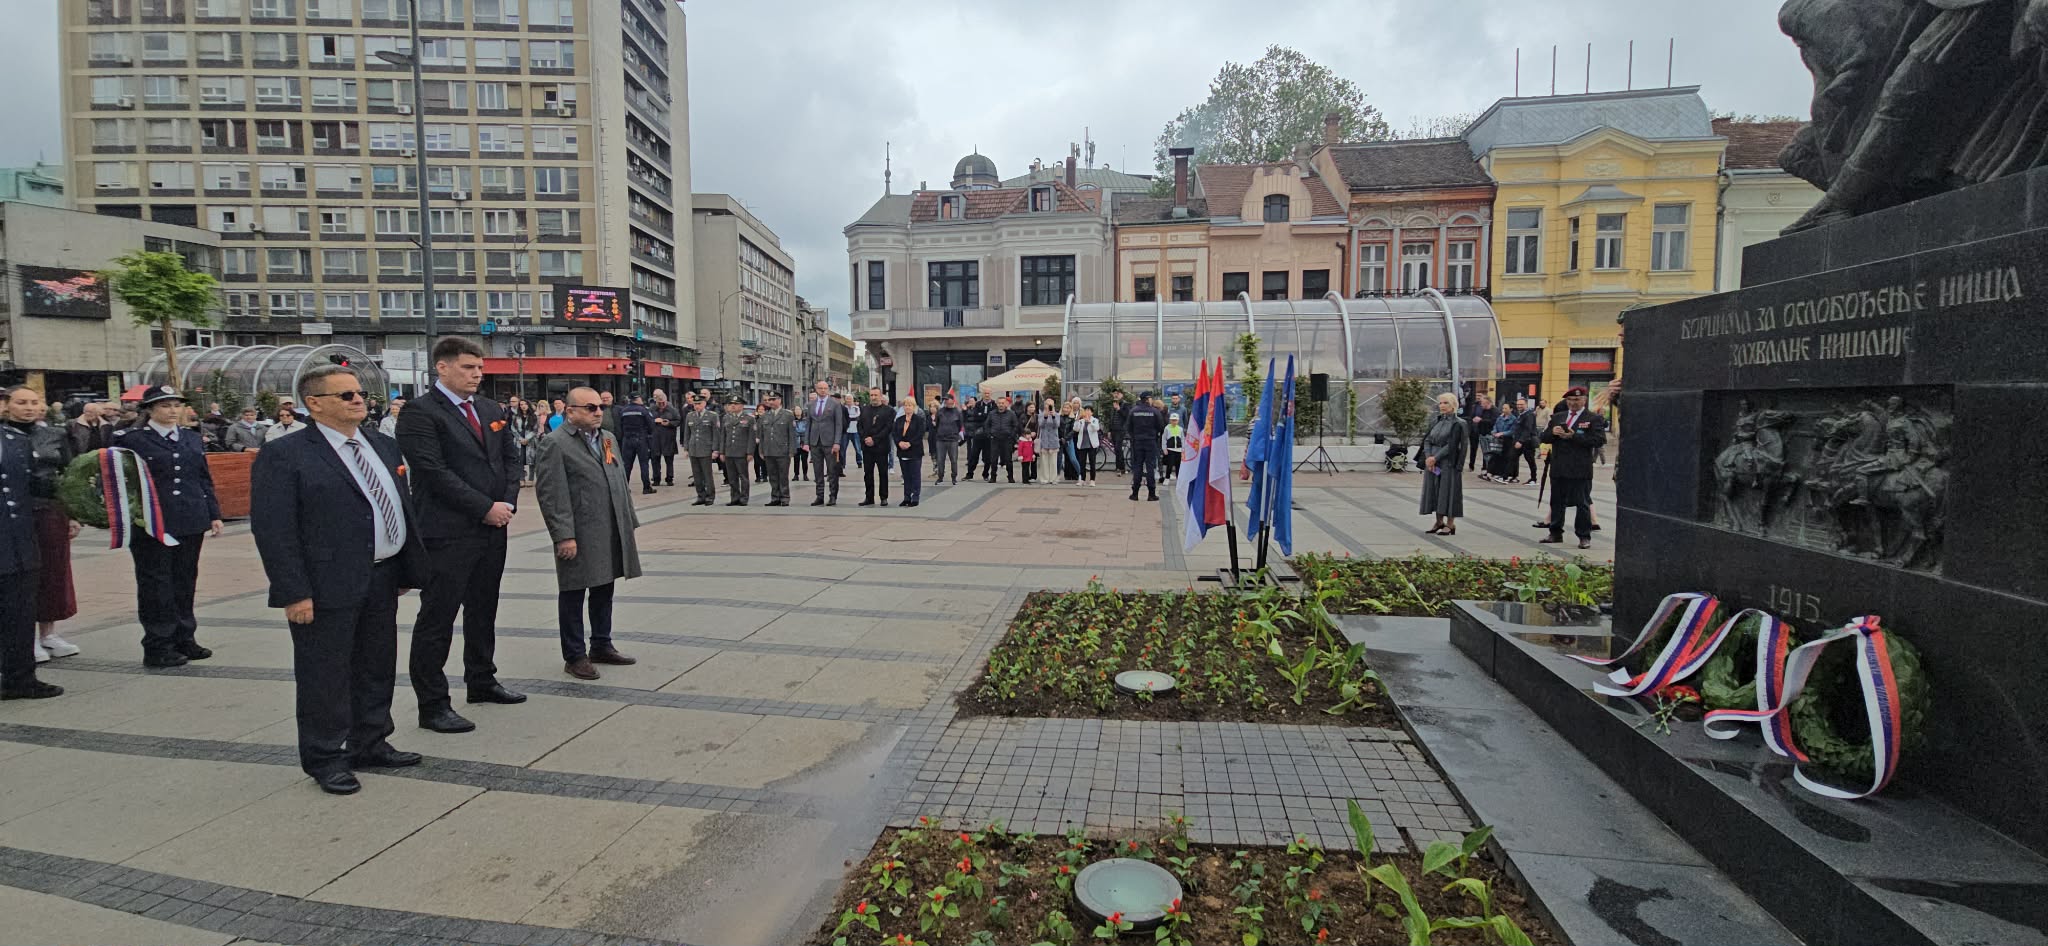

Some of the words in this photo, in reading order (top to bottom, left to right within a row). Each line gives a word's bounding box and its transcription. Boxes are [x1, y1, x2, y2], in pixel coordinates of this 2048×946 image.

[1756, 306, 1776, 331] ЗА
[1783, 281, 1926, 327] ОСЛОБОЂЕЊЕ
[1939, 266, 2023, 306] НИША
[1729, 337, 1811, 367] ЗАХВАЛНЕ
[1820, 327, 1914, 360] НИШЛИЈЕ
[1769, 584, 1821, 623] 1915
